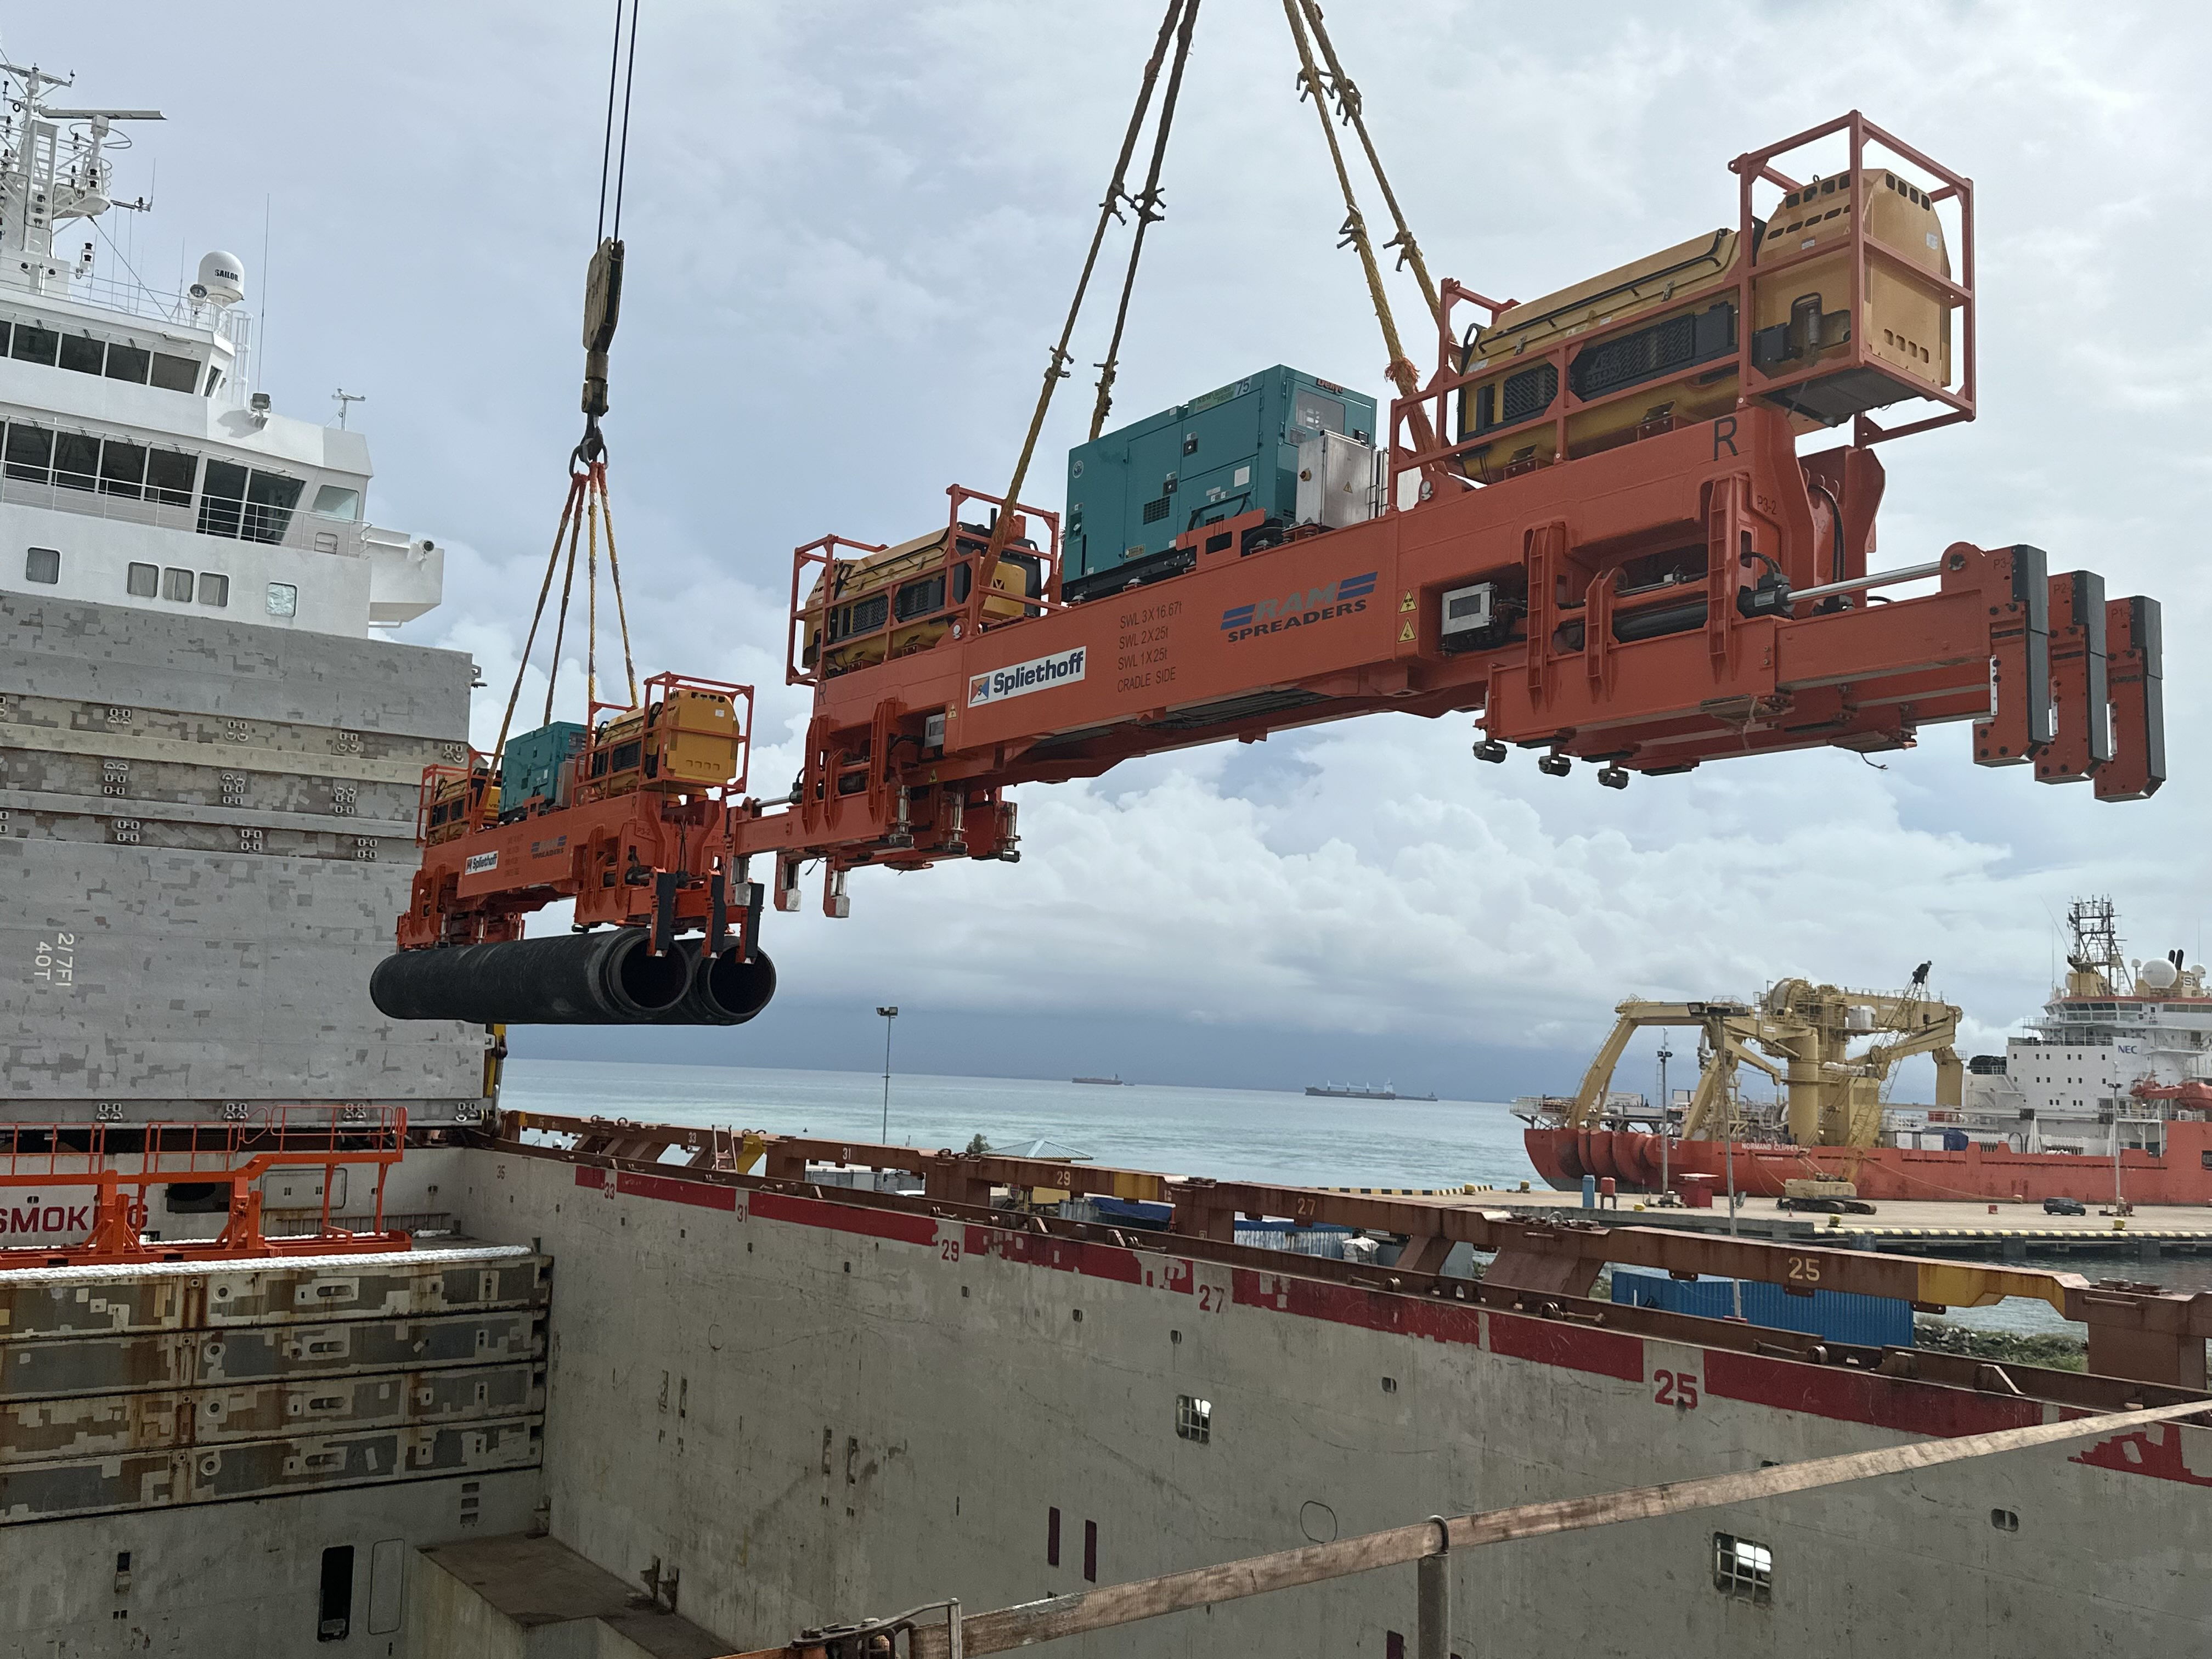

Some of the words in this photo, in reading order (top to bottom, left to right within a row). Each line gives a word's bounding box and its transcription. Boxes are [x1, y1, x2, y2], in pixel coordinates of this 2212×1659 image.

[215, 269, 239, 282] SAILOR
[1237, 377, 1250, 395] 75
[1714, 417, 1738, 461] R
[1757, 495, 1777, 515] P3-2
[1255, 582, 1338, 621] RAM
[1120, 613, 1139, 629] SWL
[1228, 600, 1366, 642] SPREADERS
[1119, 634, 1138, 650] SWL
[1118, 654, 1138, 670] SWL
[994, 651, 1084, 696] Spliethoff
[1118, 673, 1151, 692] CRADLE
[1156, 667, 1176, 684] SIDE
[818, 682, 826, 706] R
[34, 941, 52, 980] 40T
[2118, 1045, 2137, 1054] NEC
[689, 1132, 696, 1143] 33
[843, 1147, 851, 1160] 31
[496, 1165, 505, 1180] 35
[1057, 1171, 1070, 1186] 29
[604, 1182, 615, 1200] 33
[737, 1204, 748, 1223] 31
[1297, 1198, 1316, 1216] 27
[941, 1239, 959, 1262] 29
[1788, 1257, 1820, 1282] 25
[1199, 1284, 1224, 1313] 27
[1654, 1369, 1697, 1409] 25
